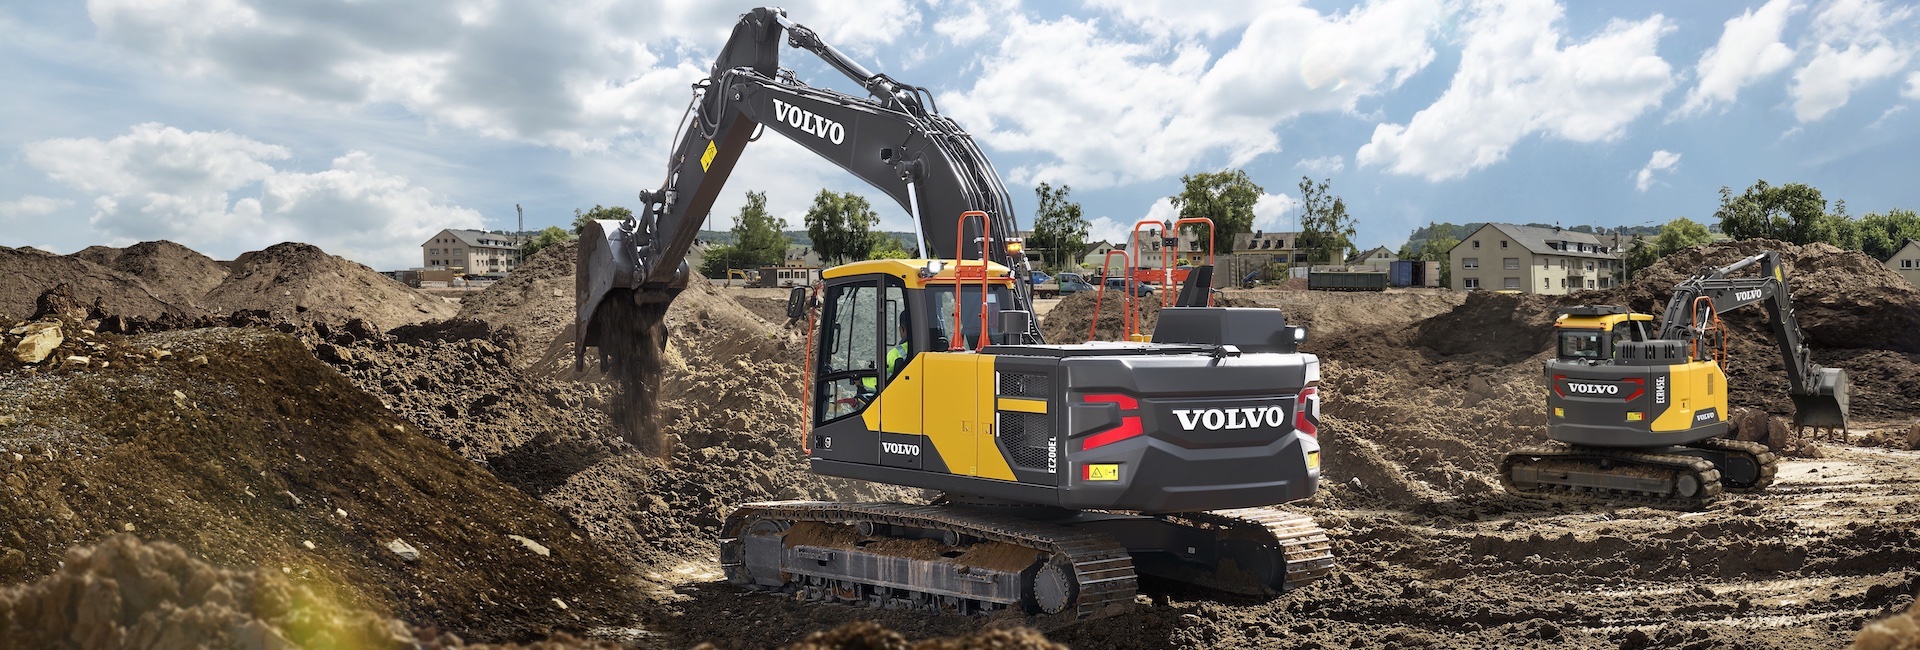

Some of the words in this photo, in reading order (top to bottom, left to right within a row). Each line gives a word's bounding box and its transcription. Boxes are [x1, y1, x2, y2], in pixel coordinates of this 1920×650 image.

[773, 98, 845, 145] VOLVO
[1735, 289, 1762, 301] VOLVO
[1568, 383, 1618, 394] VOLVO
[1656, 376, 1665, 404] ECR145EL
[1172, 406, 1284, 430] VOLVO
[1696, 412, 1715, 421] VOLVO
[882, 442, 919, 456] VOLVO
[1048, 436, 1056, 473] EC200EL
